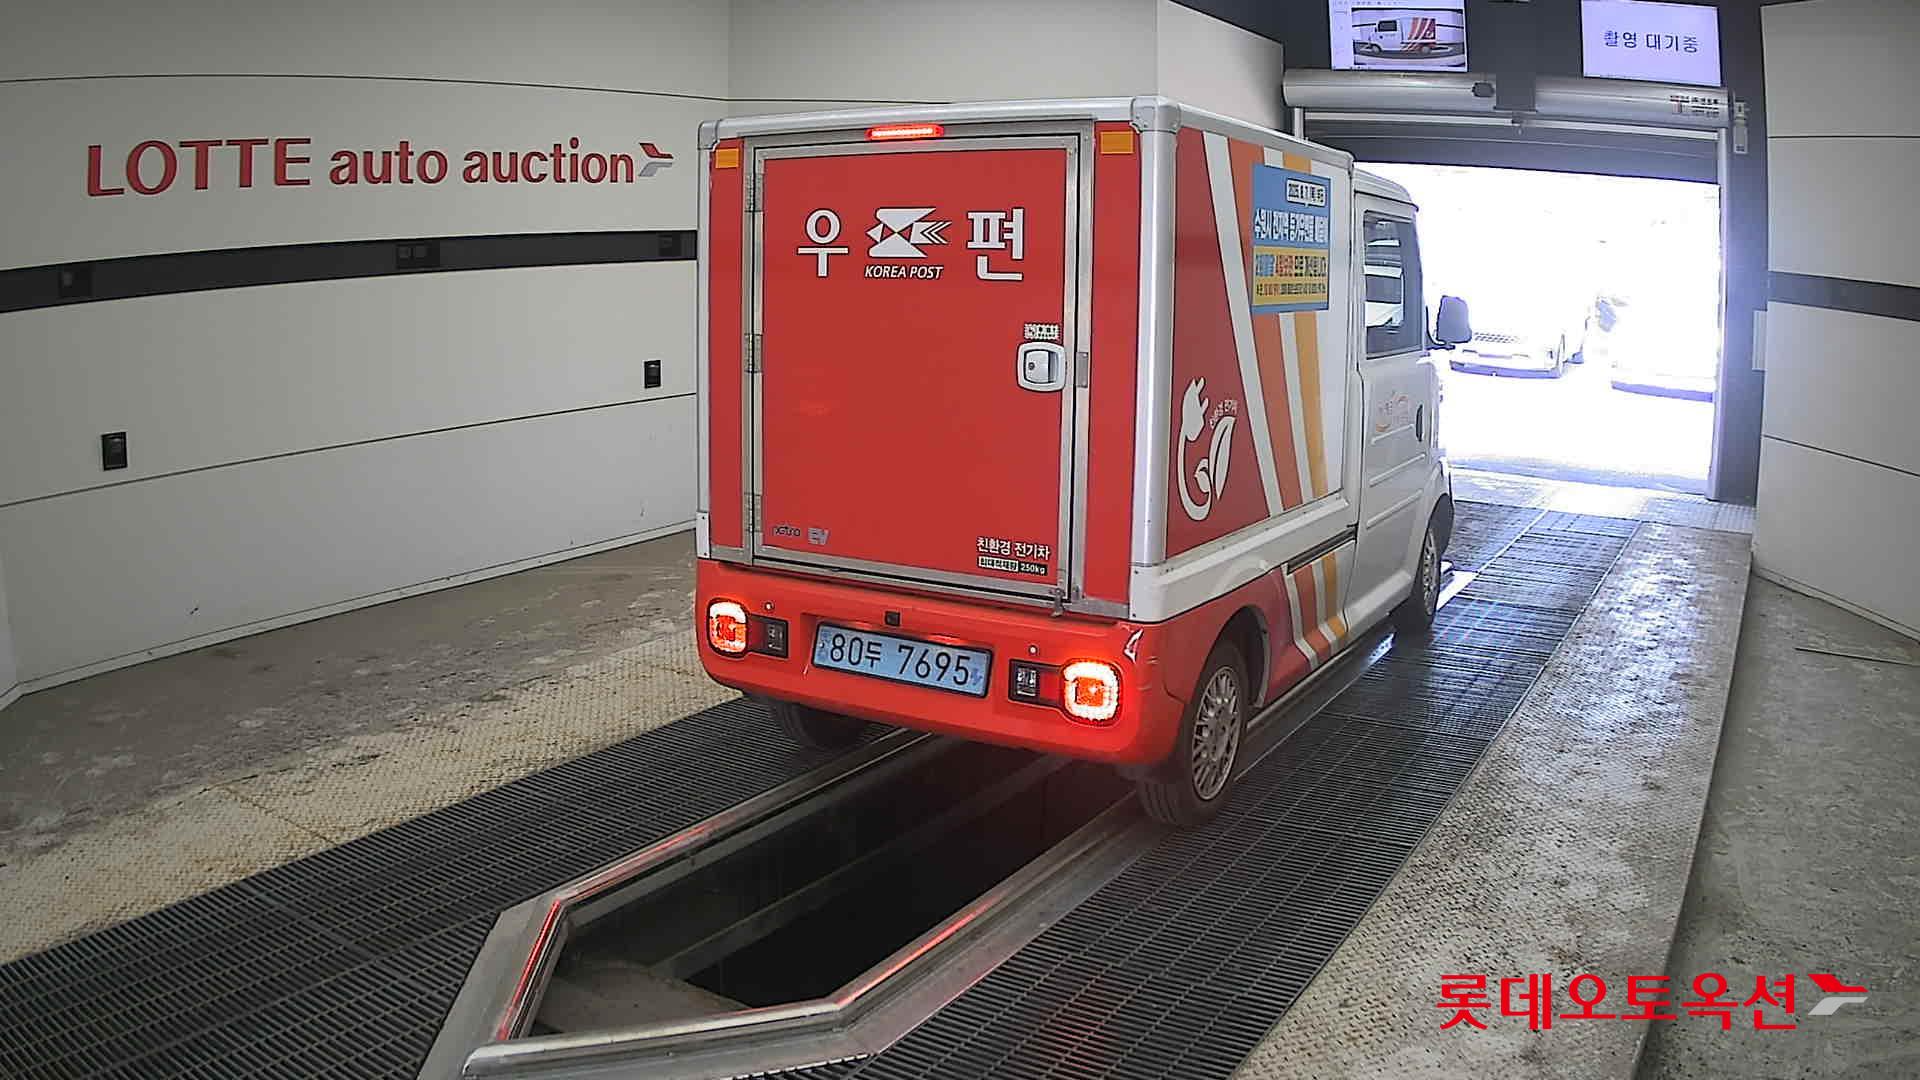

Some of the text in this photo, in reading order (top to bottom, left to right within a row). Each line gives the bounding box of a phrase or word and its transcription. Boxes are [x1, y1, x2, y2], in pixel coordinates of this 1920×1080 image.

[1604, 30, 1698, 53] 촬영 대기중
[87, 137, 635, 197] LOTTE auto auction
[797, 208, 1024, 280] 우 편
[864, 265, 944, 280] KOREA POST
[976, 537, 1050, 561] 친환경 전기차
[1021, 563, 1046, 575] 250kg
[830, 633, 971, 686] 80두 7695
